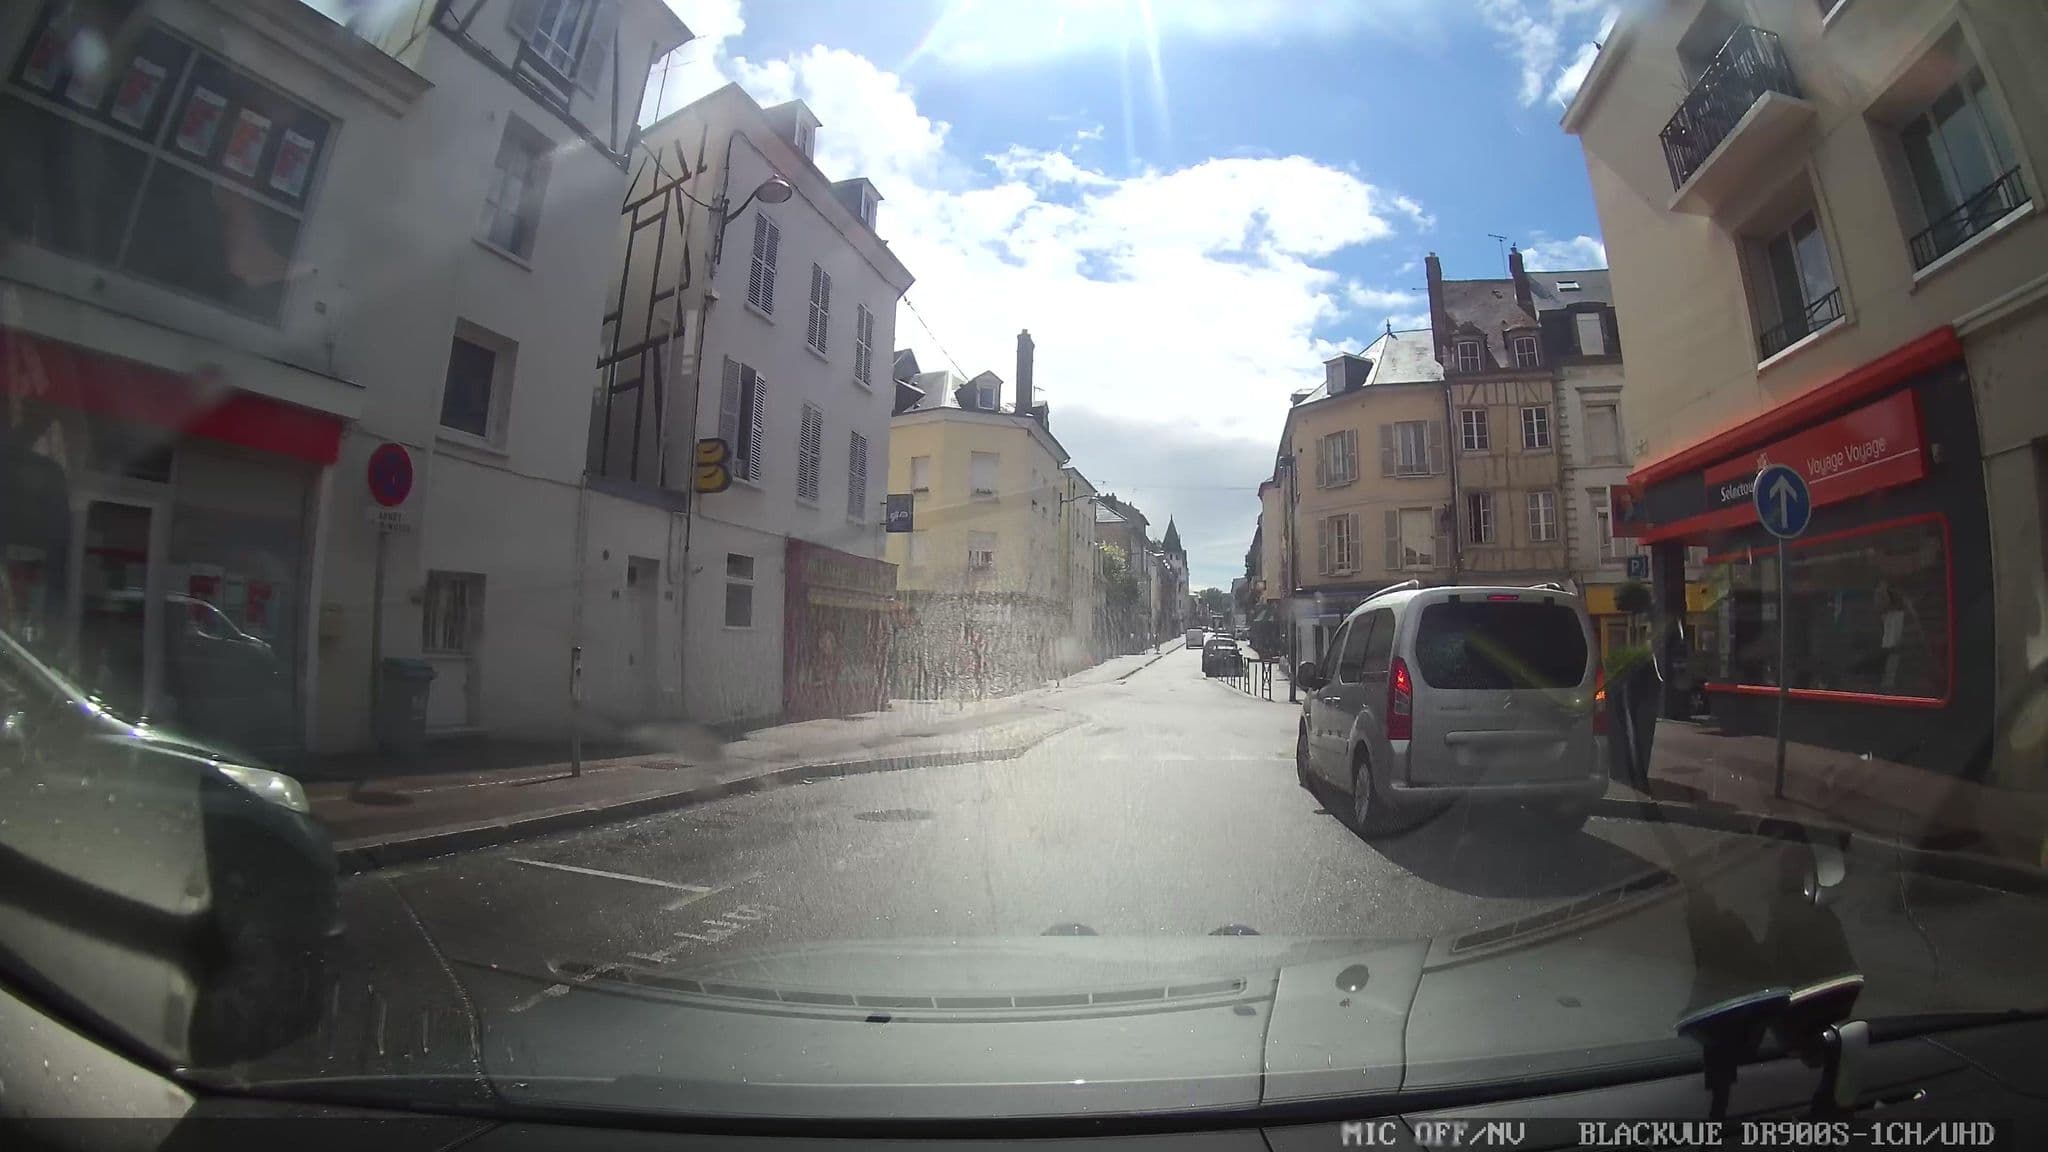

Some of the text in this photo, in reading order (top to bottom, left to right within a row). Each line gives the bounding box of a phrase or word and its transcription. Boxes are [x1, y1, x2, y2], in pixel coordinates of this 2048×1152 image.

[1806, 437, 1886, 475] Voyage Voyage
[1720, 482, 1755, 502] Selectou
[1631, 559, 1640, 573] P
